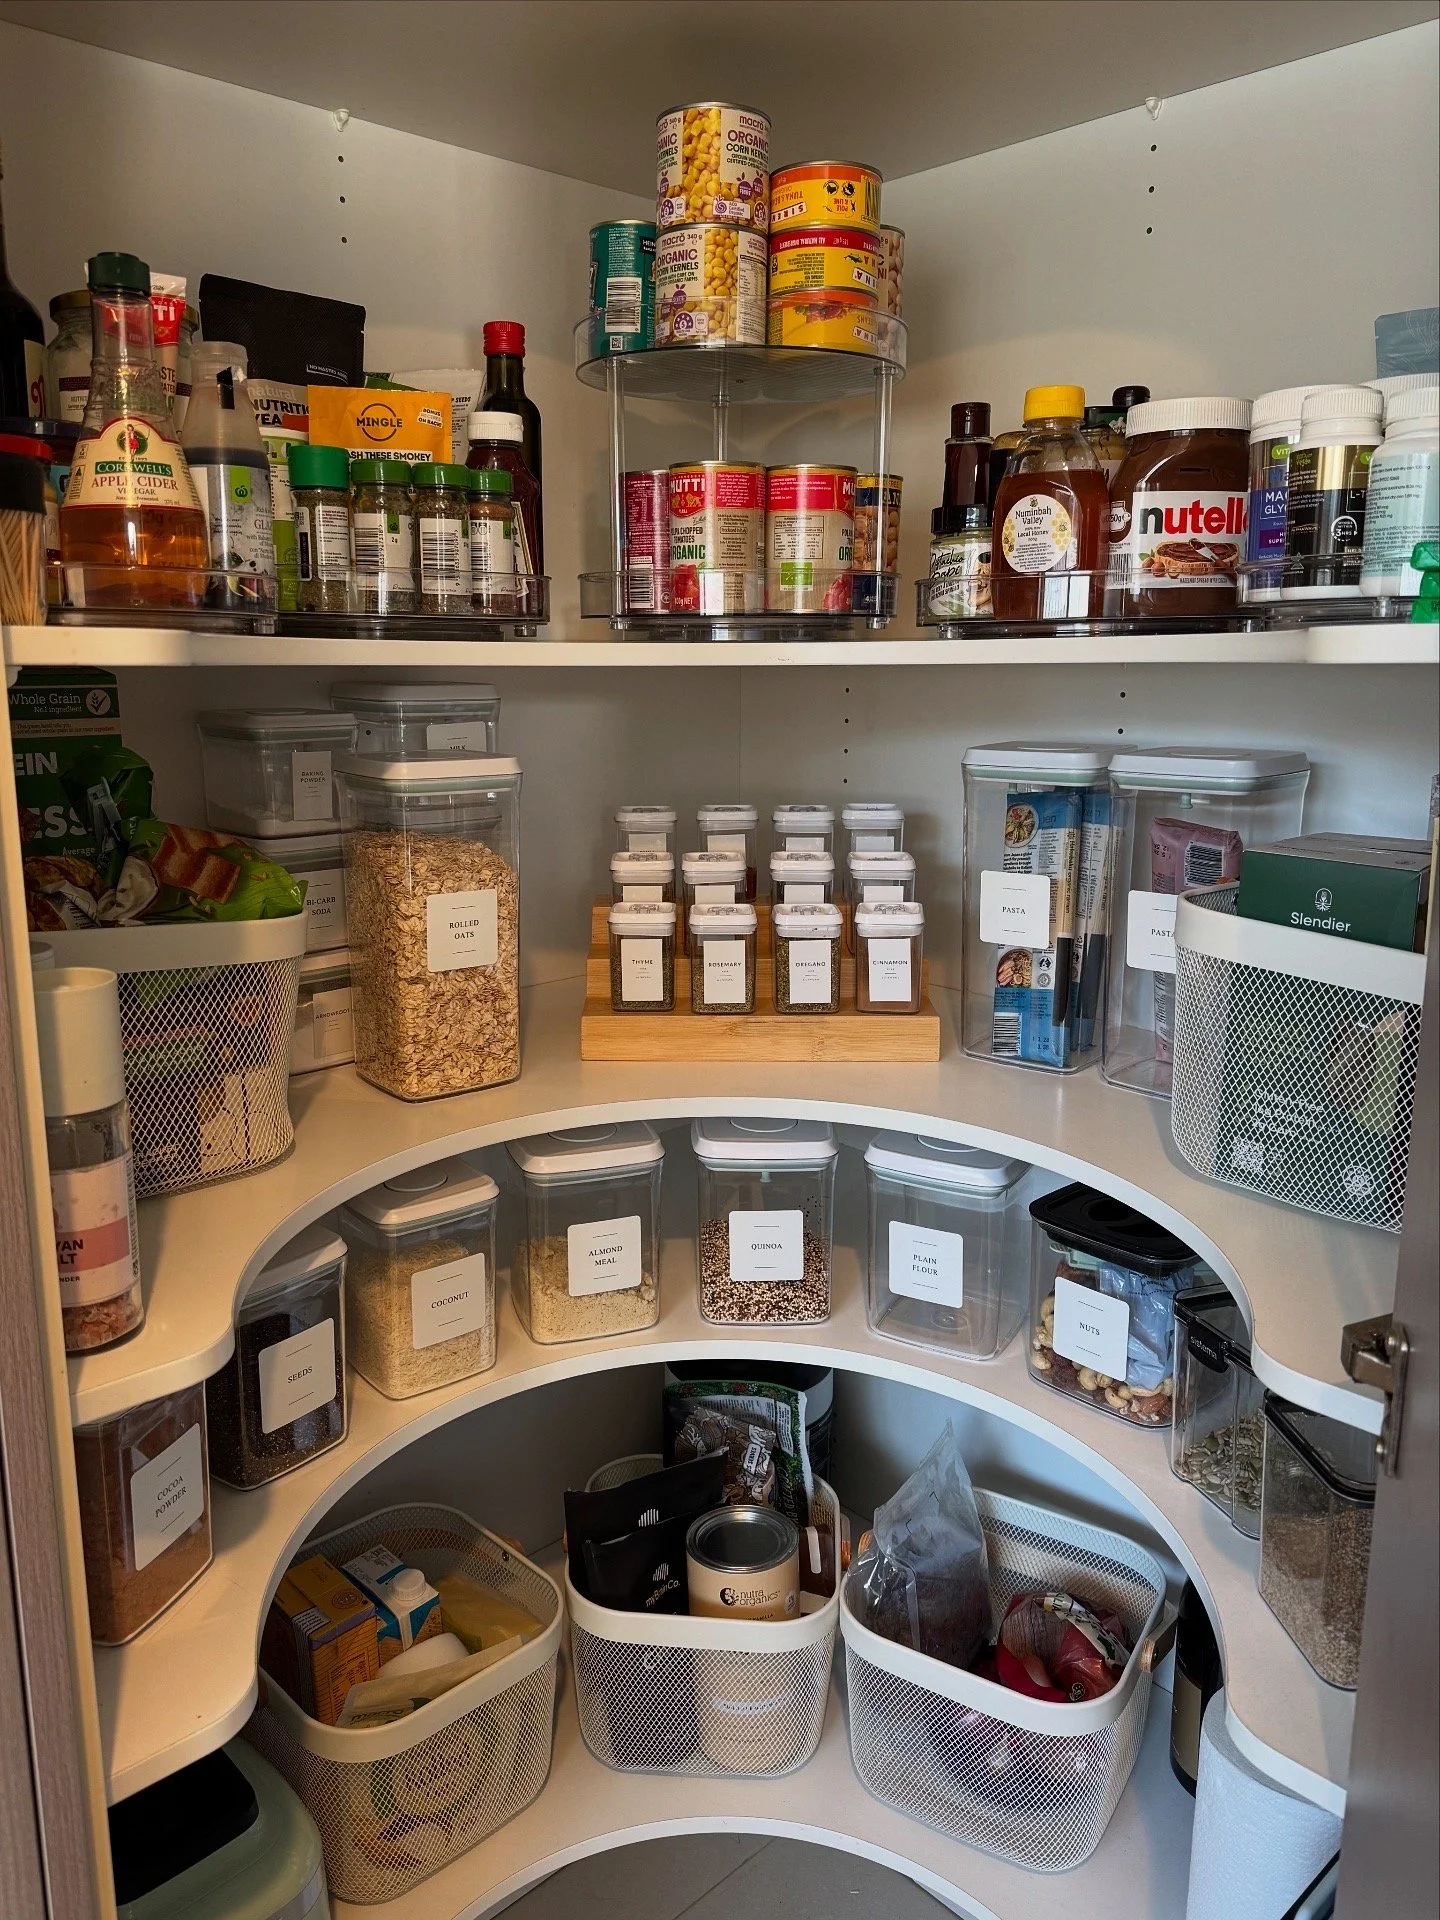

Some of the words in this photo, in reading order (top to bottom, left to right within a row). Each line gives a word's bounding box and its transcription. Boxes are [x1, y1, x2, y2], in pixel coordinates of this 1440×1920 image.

[726, 143, 749, 156] CORN
[657, 248, 698, 267] ORGANIC
[669, 261, 699, 273] KERNELS
[356, 416, 403, 428] MINGLE
[364, 451, 392, 460] THESE
[392, 452, 432, 462] SMOKEY
[137, 475, 179, 491] CIDER
[670, 477, 706, 494] MUTTI
[117, 487, 157, 496] VIEGAR
[1015, 506, 1052, 520] Numinbah
[1139, 497, 1248, 535] nutell
[1022, 516, 1044, 527] Valley
[680, 526, 704, 535] CHOPPED
[670, 544, 706, 561] RGANIC
[684, 596, 694, 605] NET
[49, 693, 82, 705] Grain
[48, 705, 83, 714] ingredient
[306, 896, 336, 906] BI-CARB
[311, 908, 332, 916] SODA
[1002, 906, 1027, 915] PASTA
[449, 919, 480, 929] ROLLED
[454, 931, 475, 940] OATS
[588, 1245, 623, 1257] ALMOND
[750, 1243, 783, 1251] QUINOA
[594, 1257, 618, 1267] MEAL
[912, 1253, 938, 1266] PLAIN
[911, 1264, 938, 1277] FLOUR
[430, 1290, 470, 1310] COCONUT
[1079, 1321, 1101, 1337] NUTS
[1190, 1335, 1218, 1361] sistema
[286, 1365, 313, 1384] SEEDS
[157, 1474, 184, 1501] COCOA
[154, 1485, 187, 1518] POWDER
[739, 1589, 764, 1599] nutra
[739, 1592, 778, 1607] organics
